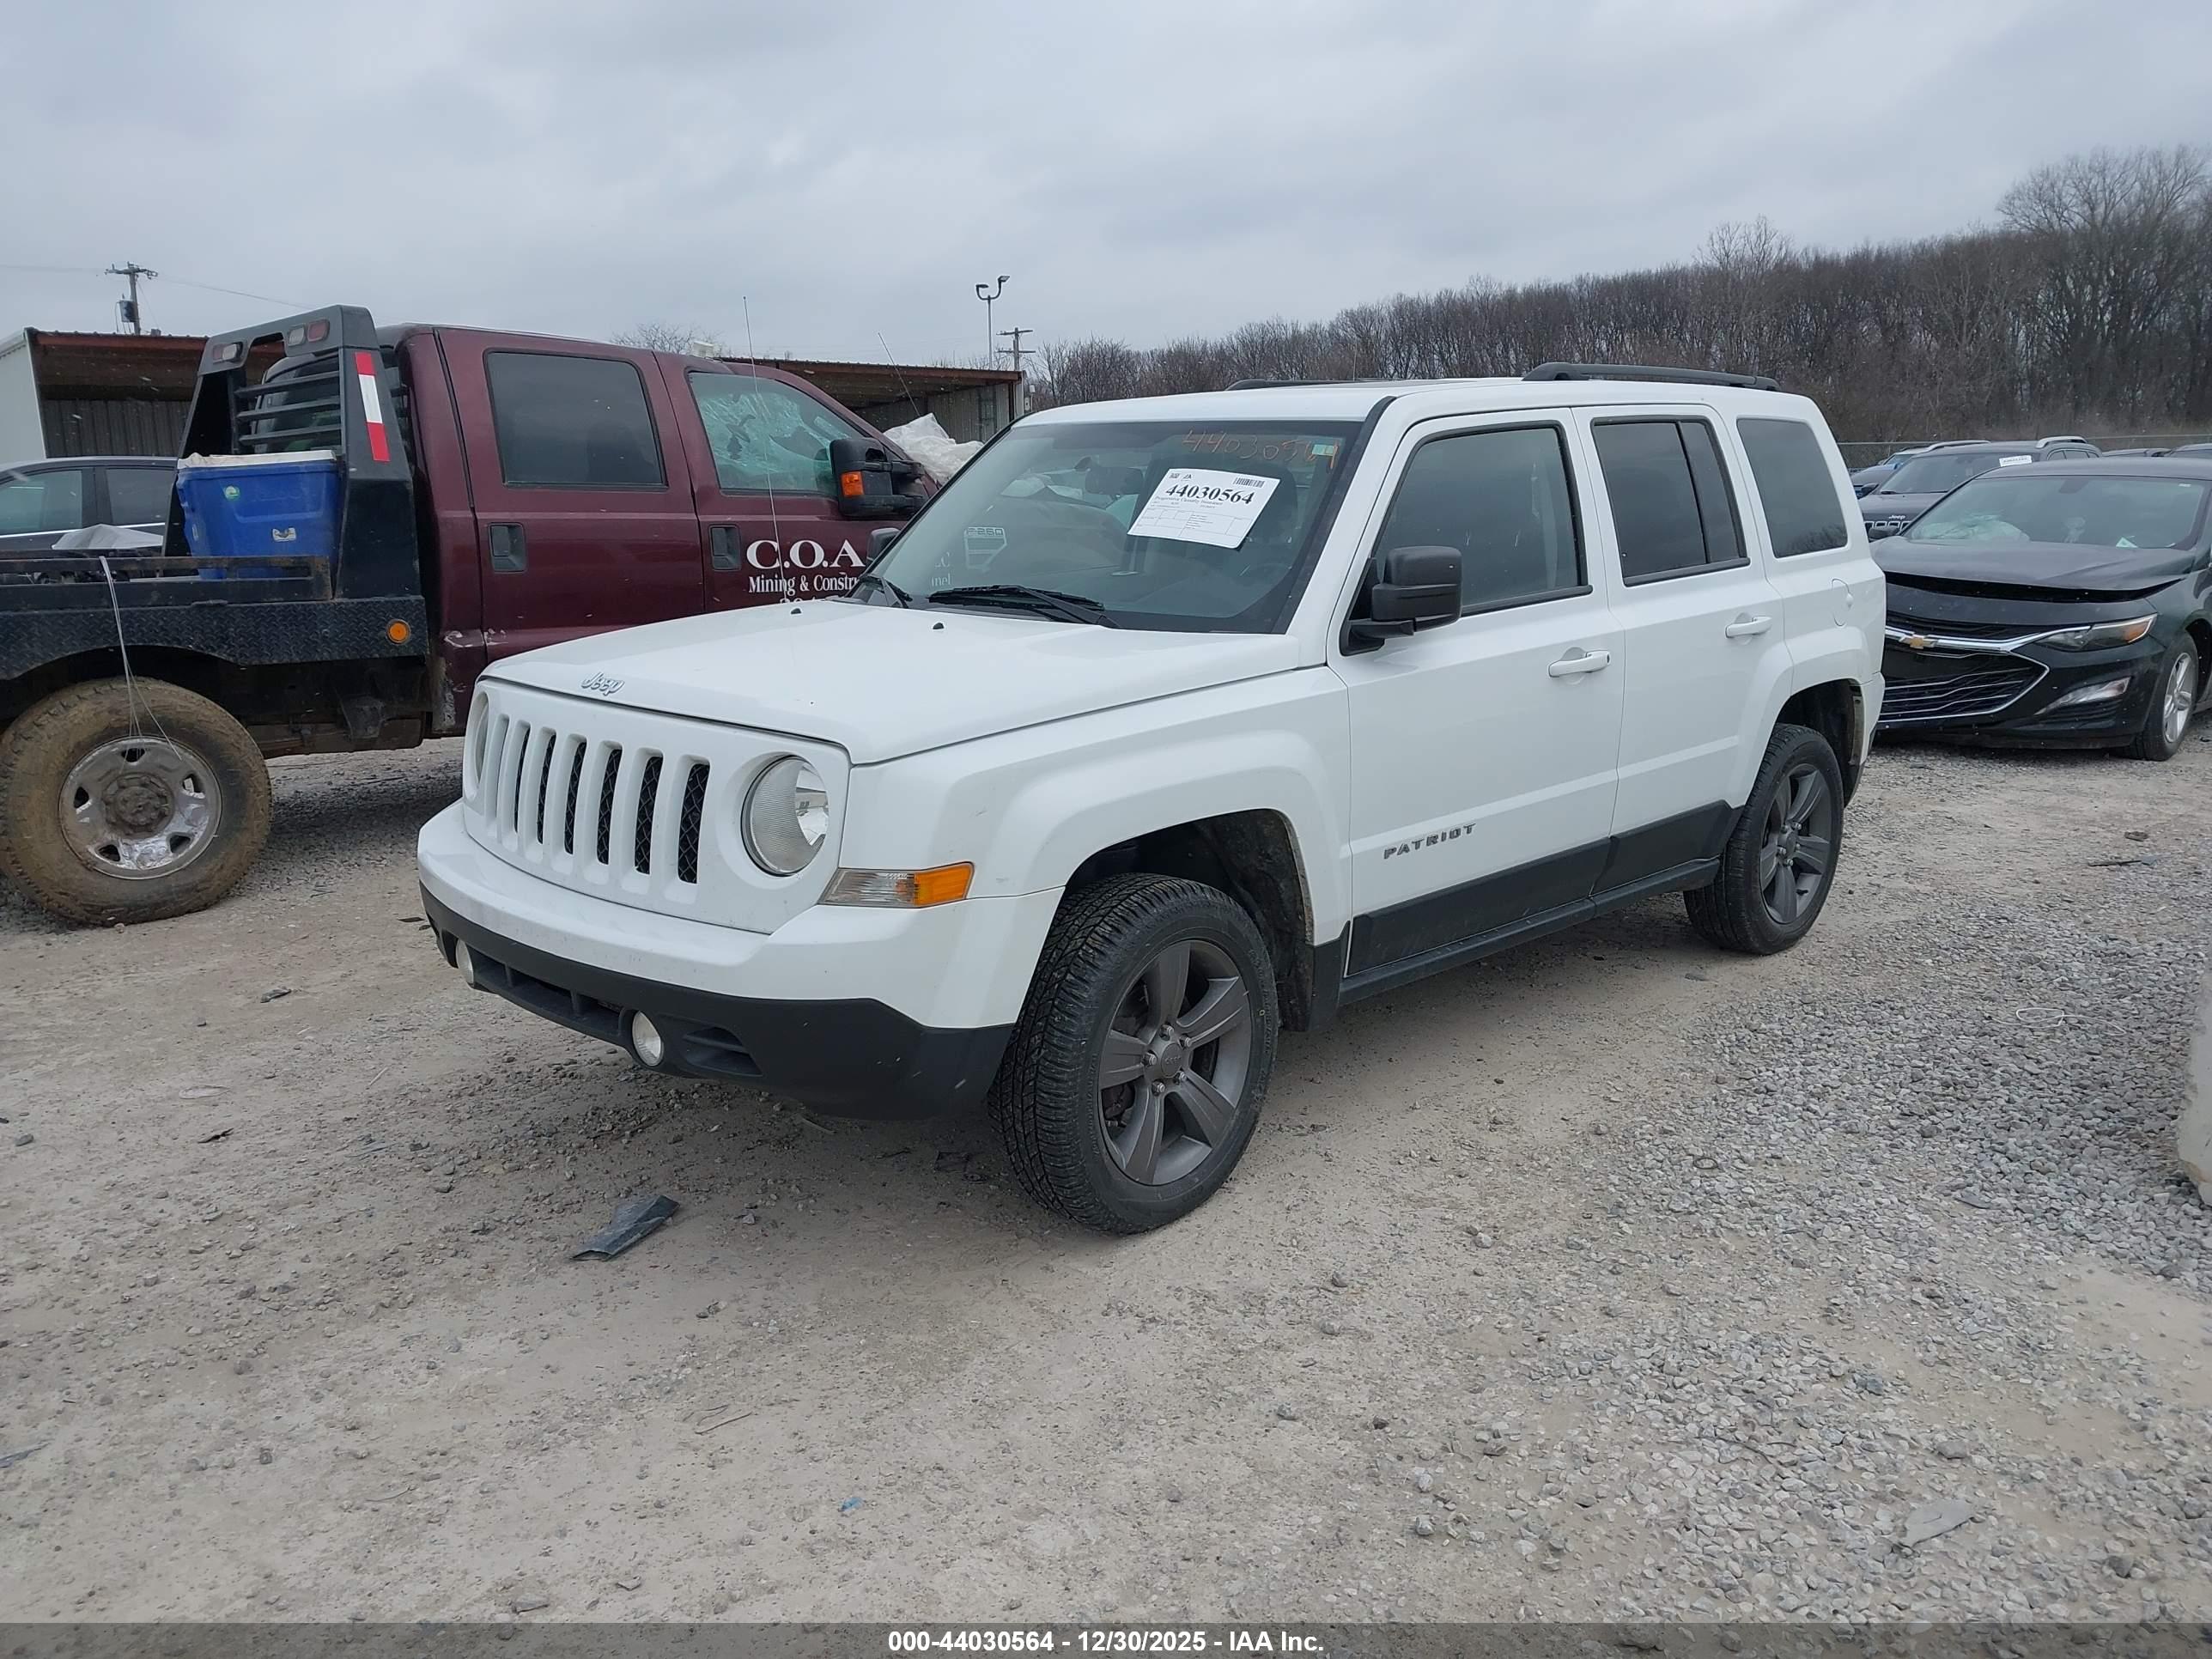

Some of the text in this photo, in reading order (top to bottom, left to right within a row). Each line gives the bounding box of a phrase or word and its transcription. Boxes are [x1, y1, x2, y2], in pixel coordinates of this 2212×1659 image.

[1165, 484, 1255, 505] 44030564
[748, 574, 796, 597] Mining
[799, 574, 811, 592] &
[581, 672, 625, 696] Jeep
[1383, 823, 1477, 860] PATRIOT
